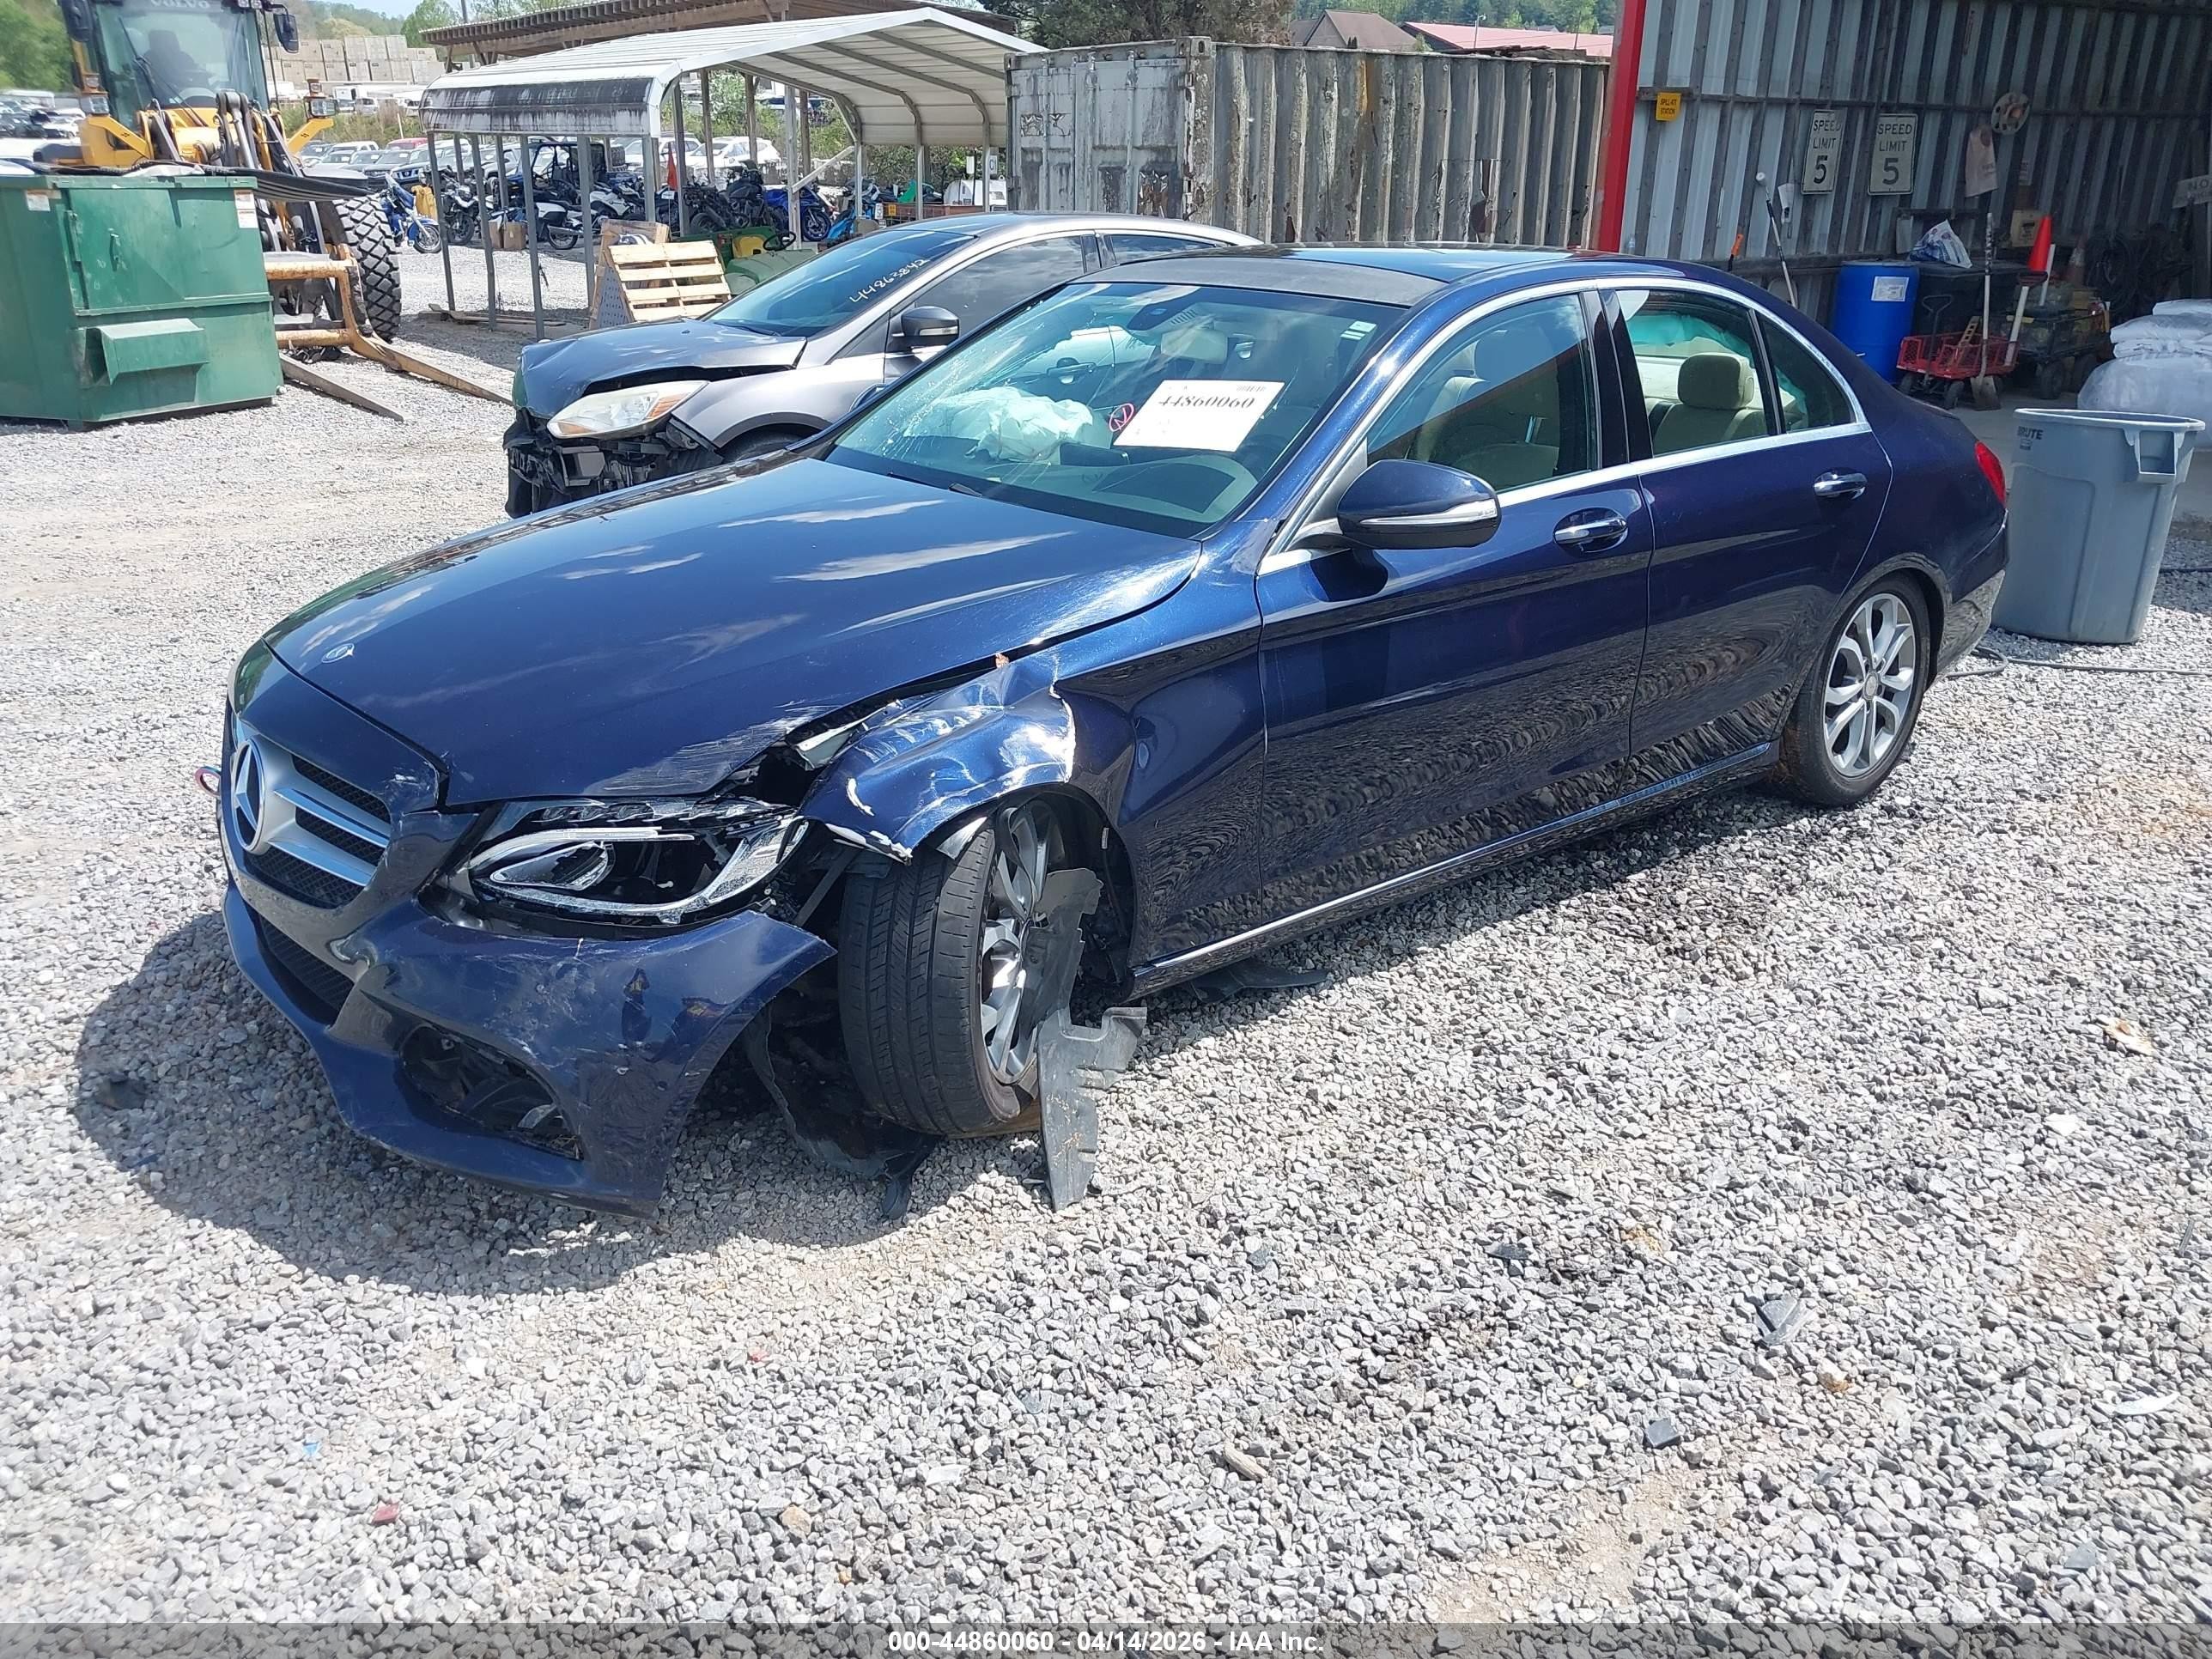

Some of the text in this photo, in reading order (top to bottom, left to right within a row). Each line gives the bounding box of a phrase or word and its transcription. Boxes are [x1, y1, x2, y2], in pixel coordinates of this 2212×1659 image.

[151, 0, 210, 9] VOLVO
[1813, 119, 1842, 131] SPEED
[1877, 124, 1913, 135] SPEED
[1813, 137, 1837, 149] LIMIT
[1879, 140, 1907, 152] LIMIT
[1813, 155, 1828, 184] 5
[1882, 157, 1899, 185] 5
[849, 258, 931, 302] 44863842
[1158, 395, 1255, 409] 44860060
